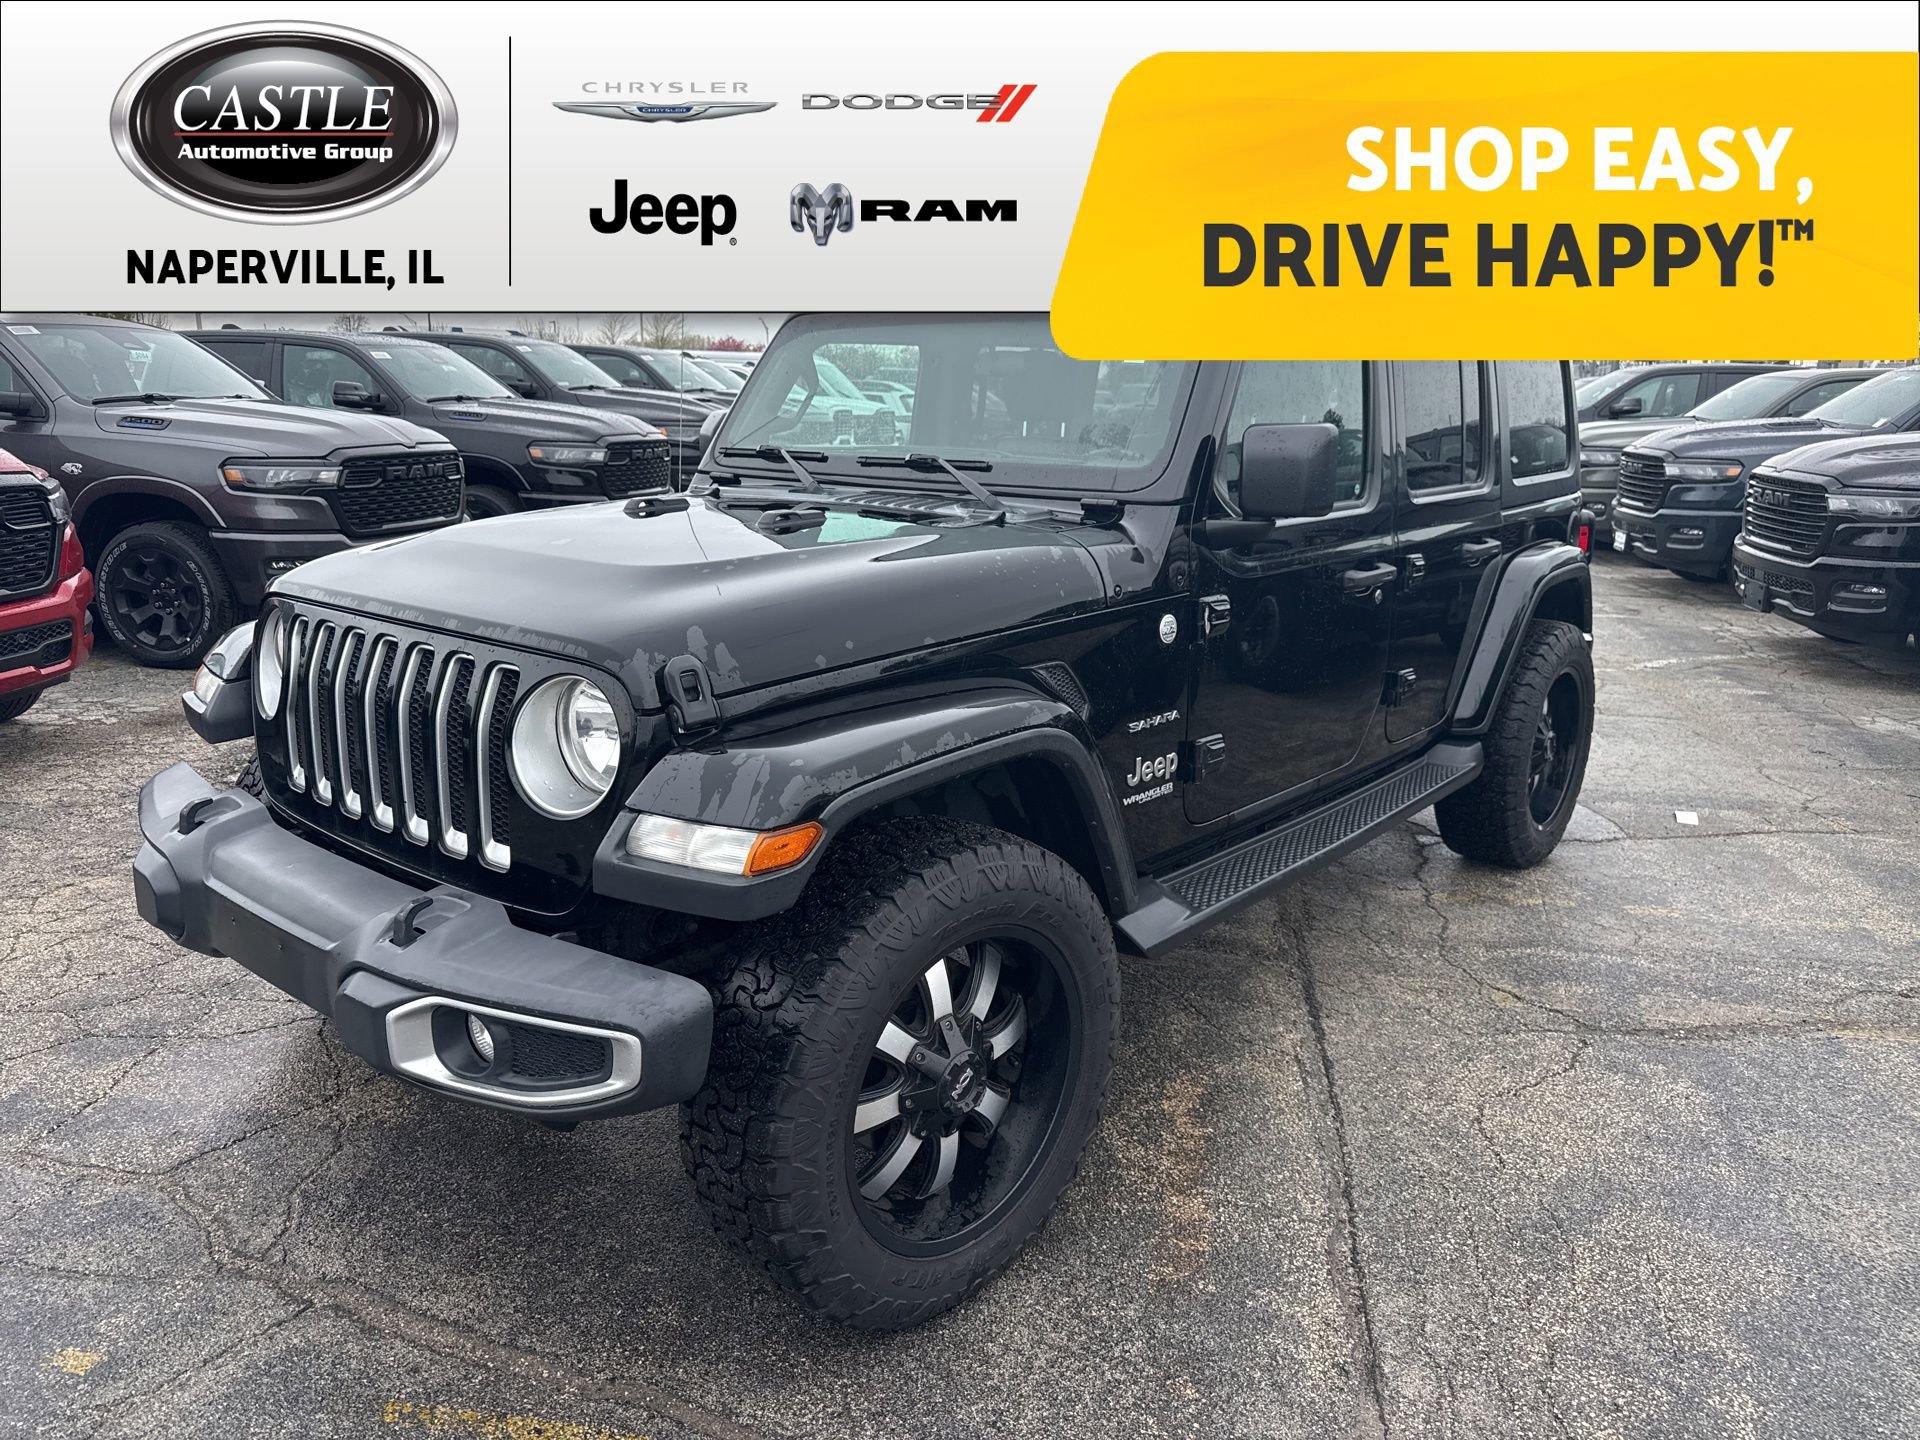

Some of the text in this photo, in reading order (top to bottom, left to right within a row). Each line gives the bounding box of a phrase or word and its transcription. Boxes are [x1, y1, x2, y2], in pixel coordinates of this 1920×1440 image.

[631, 448, 663, 460] RAM
[385, 463, 443, 480] RAM
[1751, 487, 1791, 506] RAM
[1127, 709, 1180, 734] SAHARA
[1127, 752, 1179, 787] Jeep
[1122, 782, 1174, 807] WRANGLER
